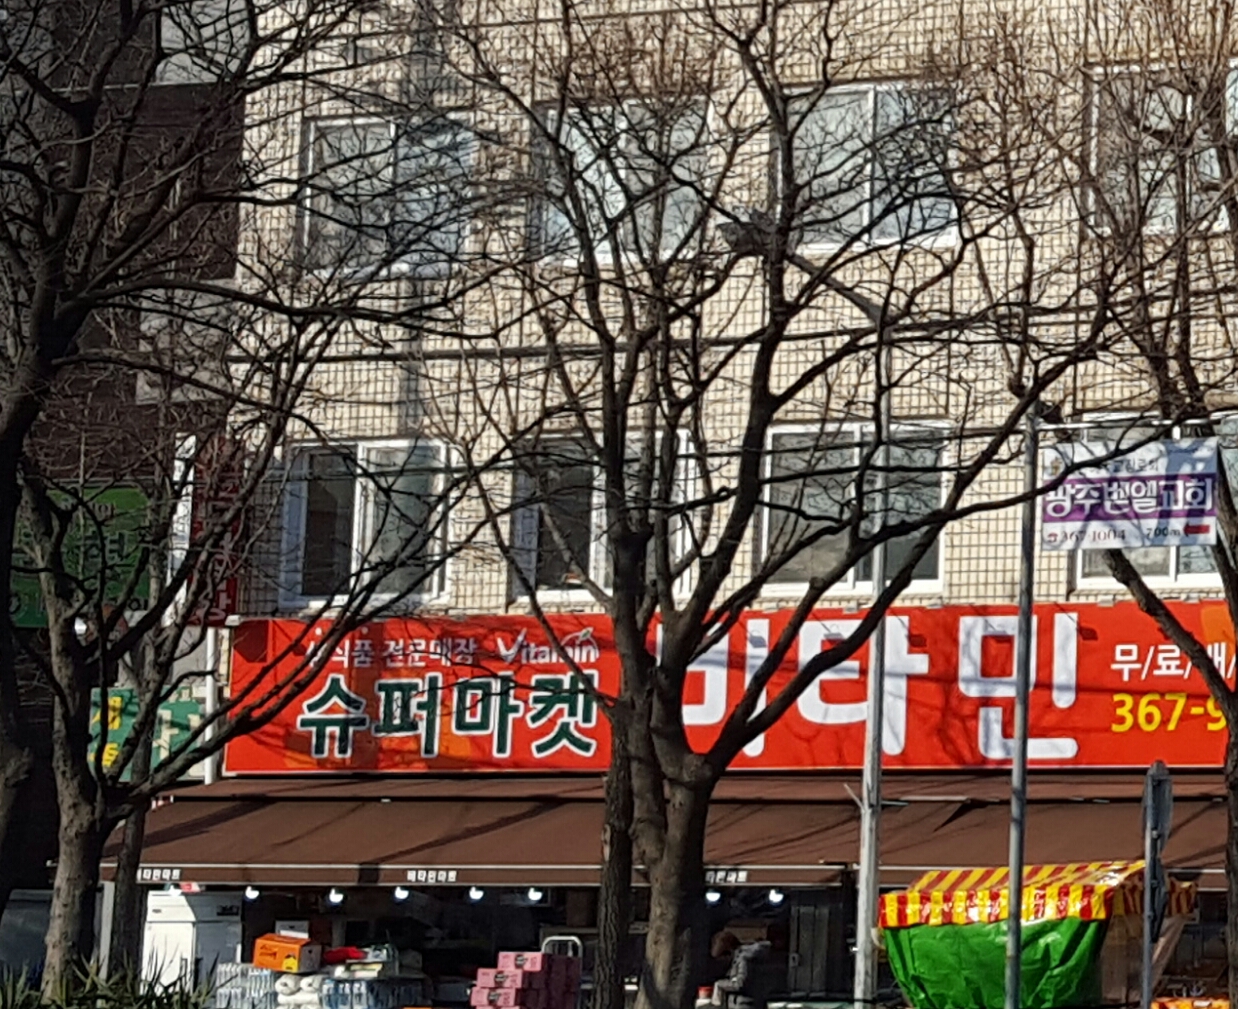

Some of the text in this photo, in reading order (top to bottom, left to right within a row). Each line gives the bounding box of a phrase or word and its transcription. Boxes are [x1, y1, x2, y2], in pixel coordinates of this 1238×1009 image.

[298, 670, 601, 759] 슈퍼마켓
[657, 612, 1079, 760] 비타민
[305, 638, 375, 668] 식품
